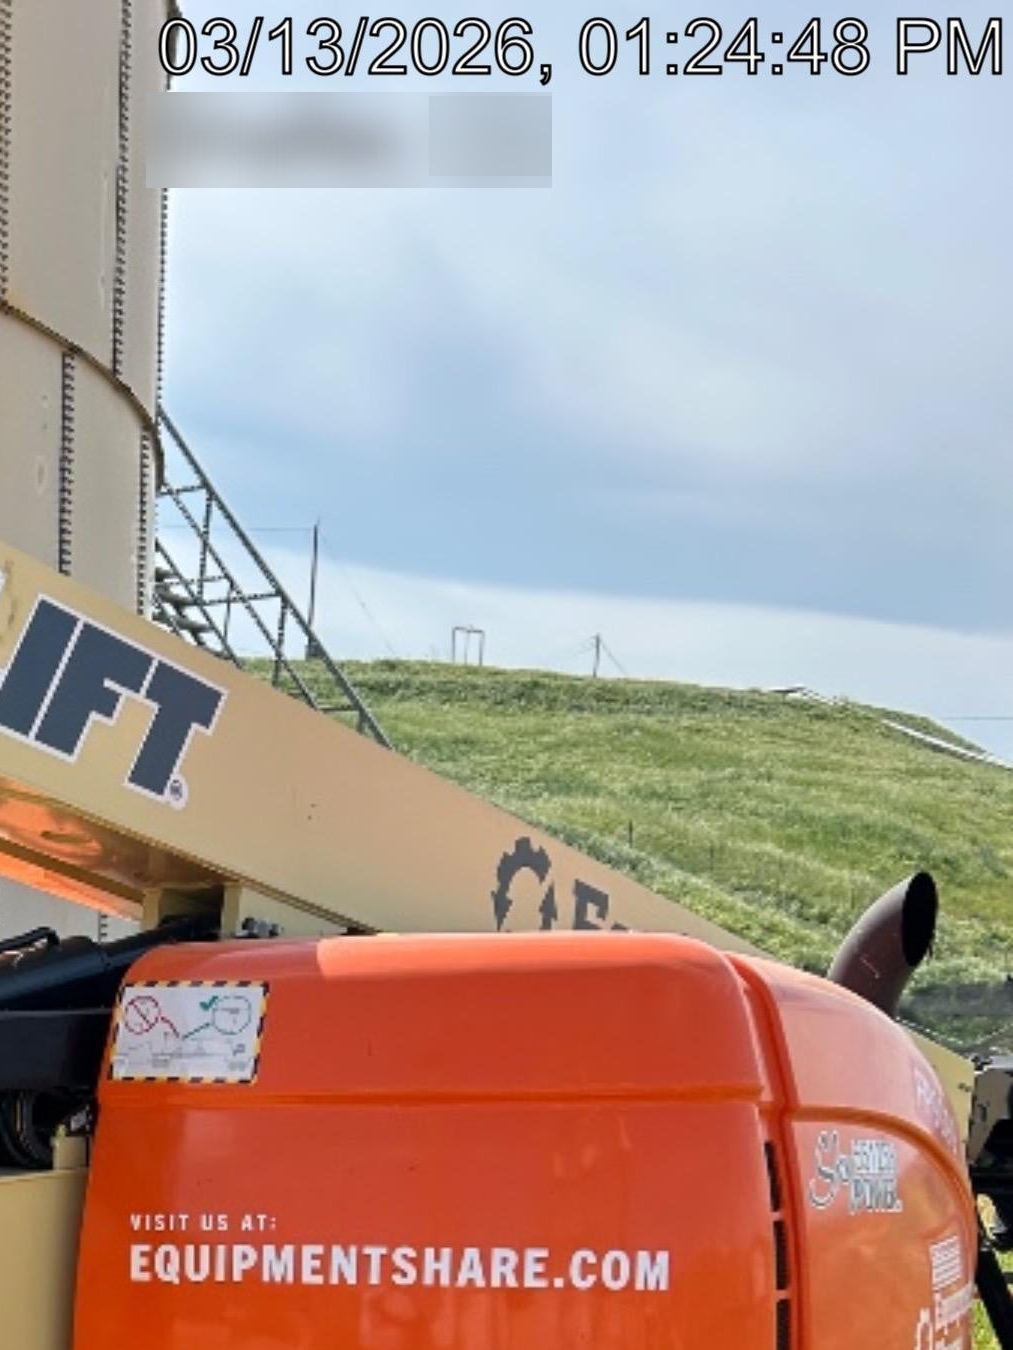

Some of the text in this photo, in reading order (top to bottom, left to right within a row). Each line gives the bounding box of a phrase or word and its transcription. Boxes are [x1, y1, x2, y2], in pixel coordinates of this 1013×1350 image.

[130, 1214, 277, 1231] VISIT US AT:
[129, 1243, 671, 1291] EQUIPMENTSHARE.COM
